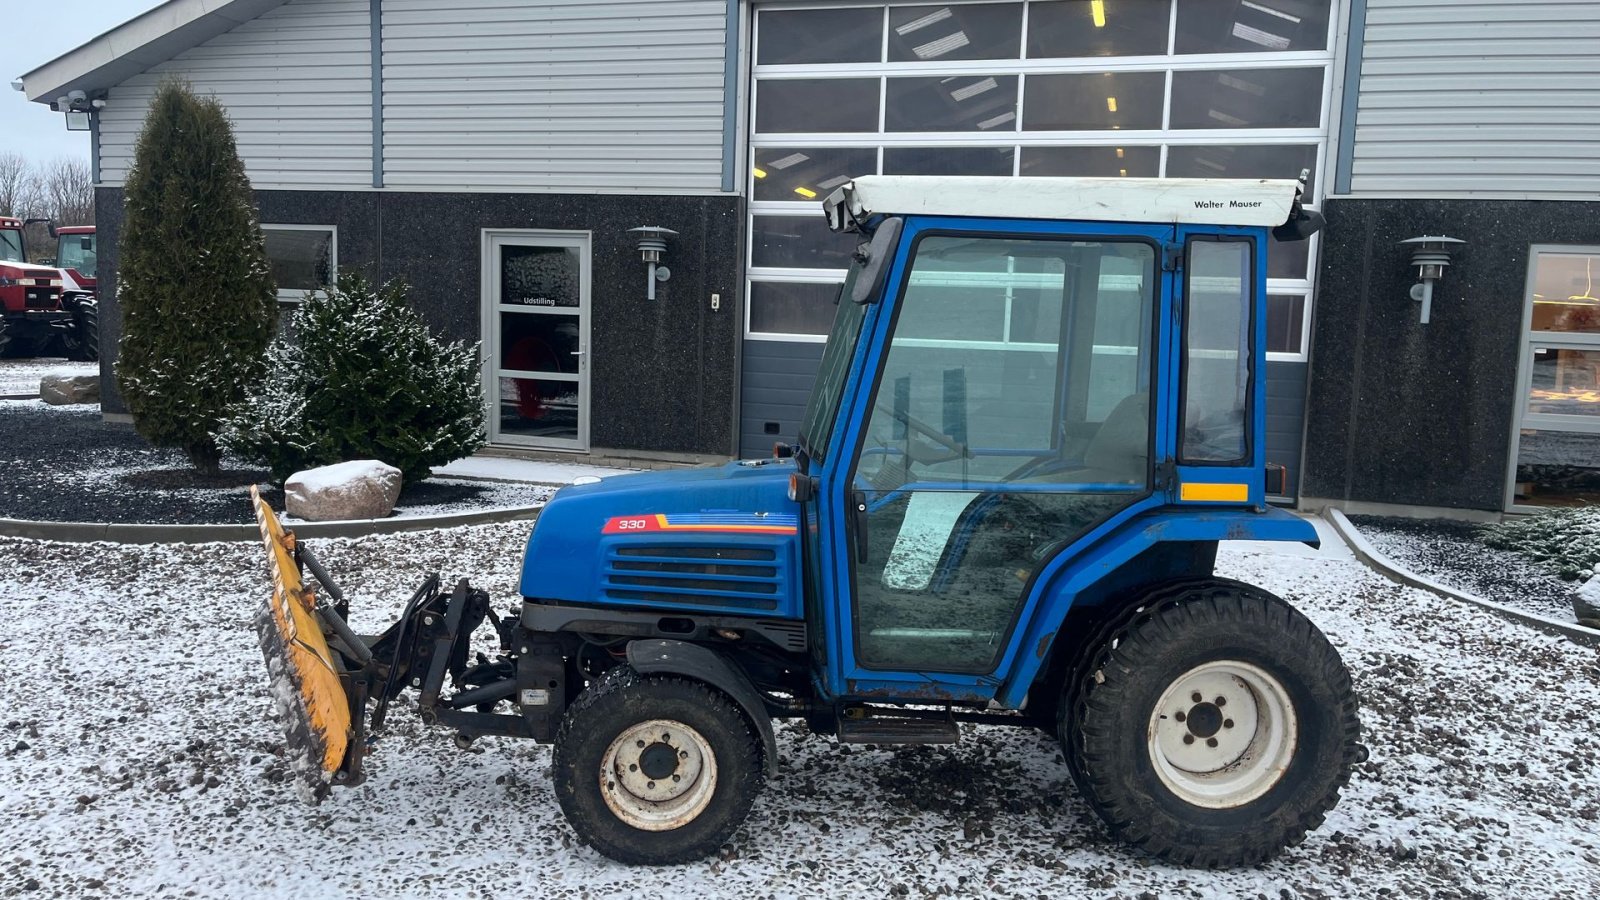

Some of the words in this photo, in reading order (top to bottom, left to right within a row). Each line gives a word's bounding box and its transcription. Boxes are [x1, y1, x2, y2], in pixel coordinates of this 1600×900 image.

[1194, 200, 1224, 209] Walter
[1229, 200, 1262, 208] Mauser
[523, 297, 555, 307] Udstilling
[618, 520, 646, 529] 330
